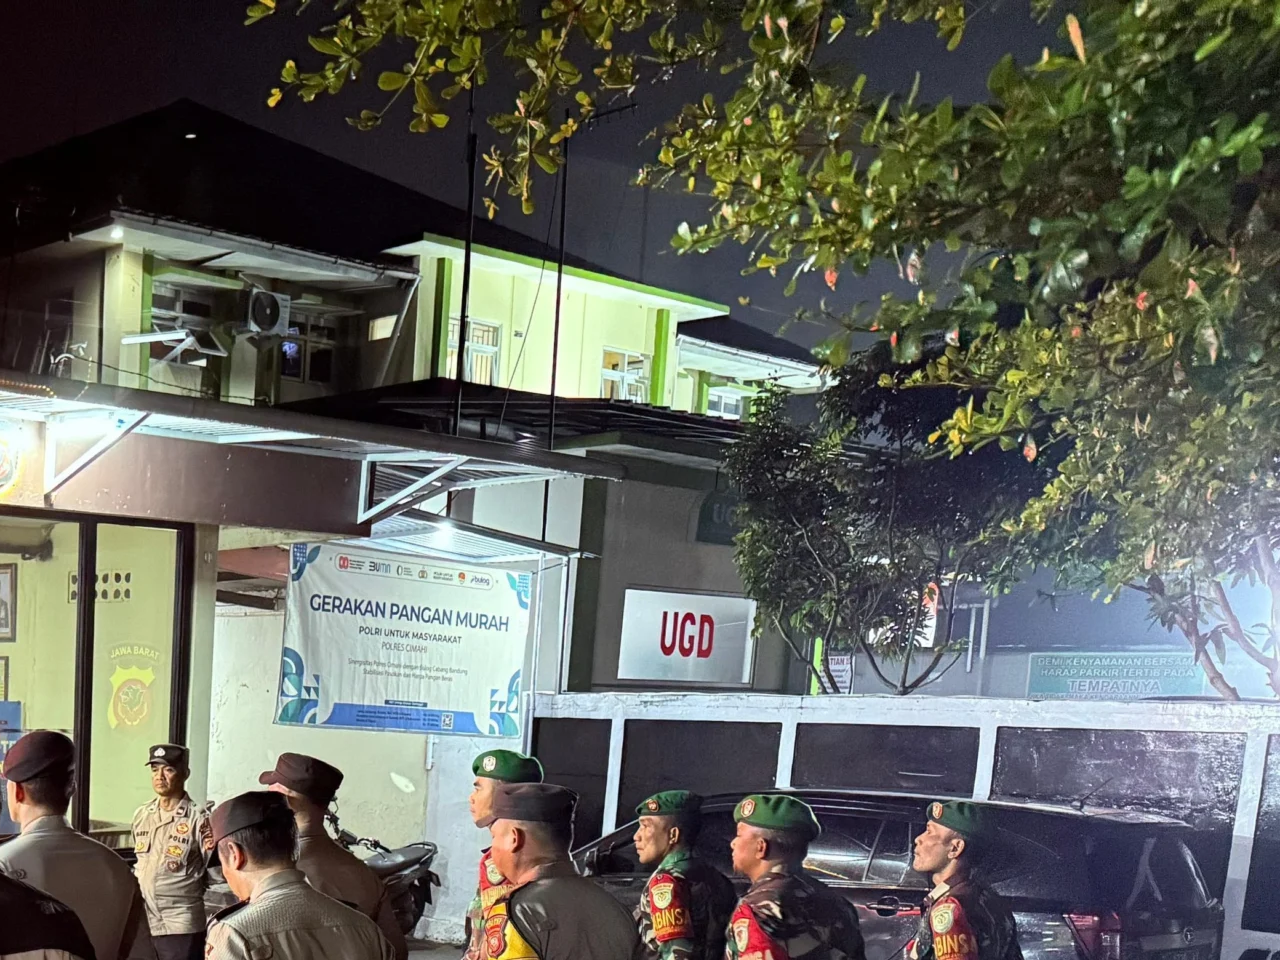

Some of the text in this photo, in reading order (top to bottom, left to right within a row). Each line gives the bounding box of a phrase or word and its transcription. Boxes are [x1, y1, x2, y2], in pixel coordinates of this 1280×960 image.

[310, 593, 510, 632] GERAKAN PANGAN MURAH
[358, 625, 462, 645] POLRI UNTUK MASYARAKAT
[660, 611, 715, 658] UGD
[111, 646, 160, 660] JAWA BARAT
[381, 641, 428, 654] POLRES CIMAHI
[1038, 657, 1064, 666] DEMI
[1066, 657, 1143, 666] KENYAMANAN
[1041, 668, 1195, 677] HARAP PARKIR TERTIB PADA
[1067, 679, 1161, 693] TEMPATNYA
[936, 933, 978, 957] BINSA
